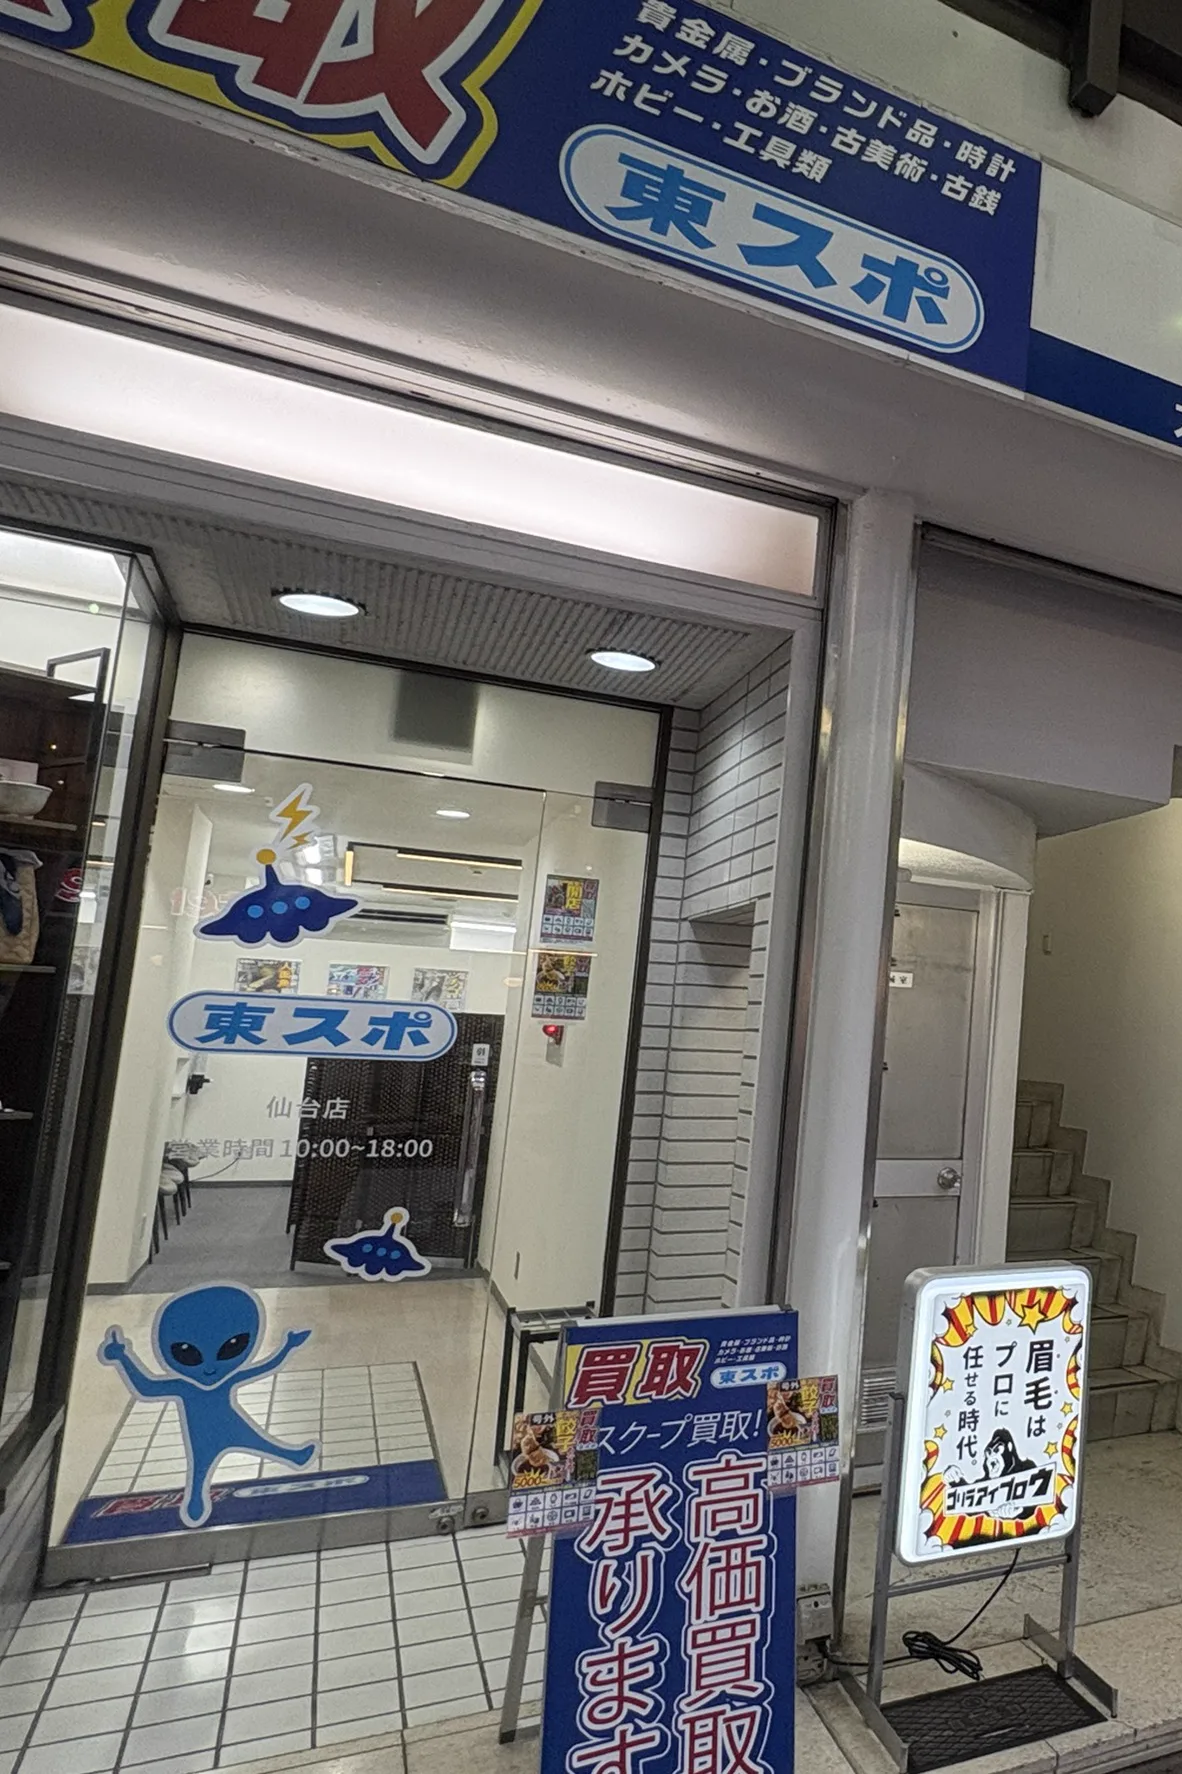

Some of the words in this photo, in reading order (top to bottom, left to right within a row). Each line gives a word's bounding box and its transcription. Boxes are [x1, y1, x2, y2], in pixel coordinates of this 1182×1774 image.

[589, 69, 833, 185] ホビー・工具類
[612, 34, 1003, 216] カメラ・お酒・古美術・古銭
[636, 0, 1017, 184] 貴金属・ブランド品・時計
[604, 152, 950, 326] 東スポ
[195, 1001, 433, 1050] 東スポ
[266, 1095, 350, 1120] 仙台店
[569, 1341, 705, 1408] 買取
[718, 1365, 780, 1385] 東スポ
[956, 1345, 985, 1467] 任せる時代。
[993, 1341, 1018, 1418] プロに
[1024, 1339, 1055, 1439] 眉毛は
[684, 1456, 767, 1774] 高価買取
